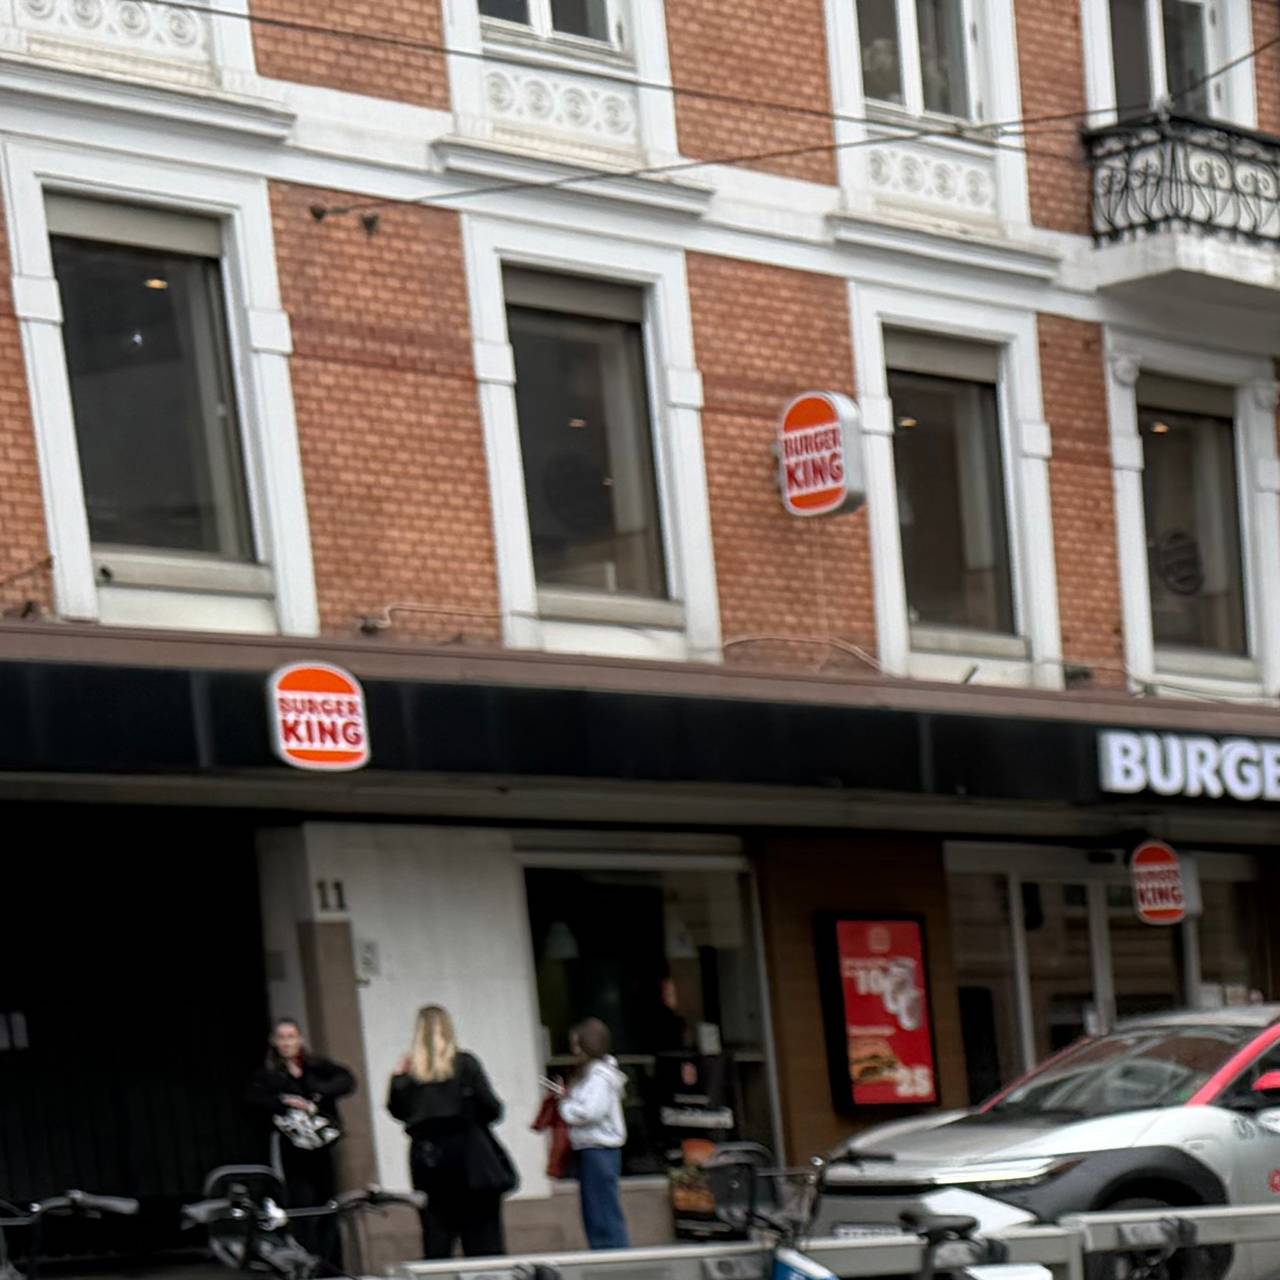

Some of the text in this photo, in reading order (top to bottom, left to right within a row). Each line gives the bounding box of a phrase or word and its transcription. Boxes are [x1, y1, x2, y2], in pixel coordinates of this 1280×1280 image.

[784, 429, 840, 458] BURGER
[786, 452, 843, 490] KING
[279, 697, 358, 717] BURGER
[282, 719, 362, 745] KING
[316, 881, 347, 910] 11
[1137, 887, 1182, 905] KING
